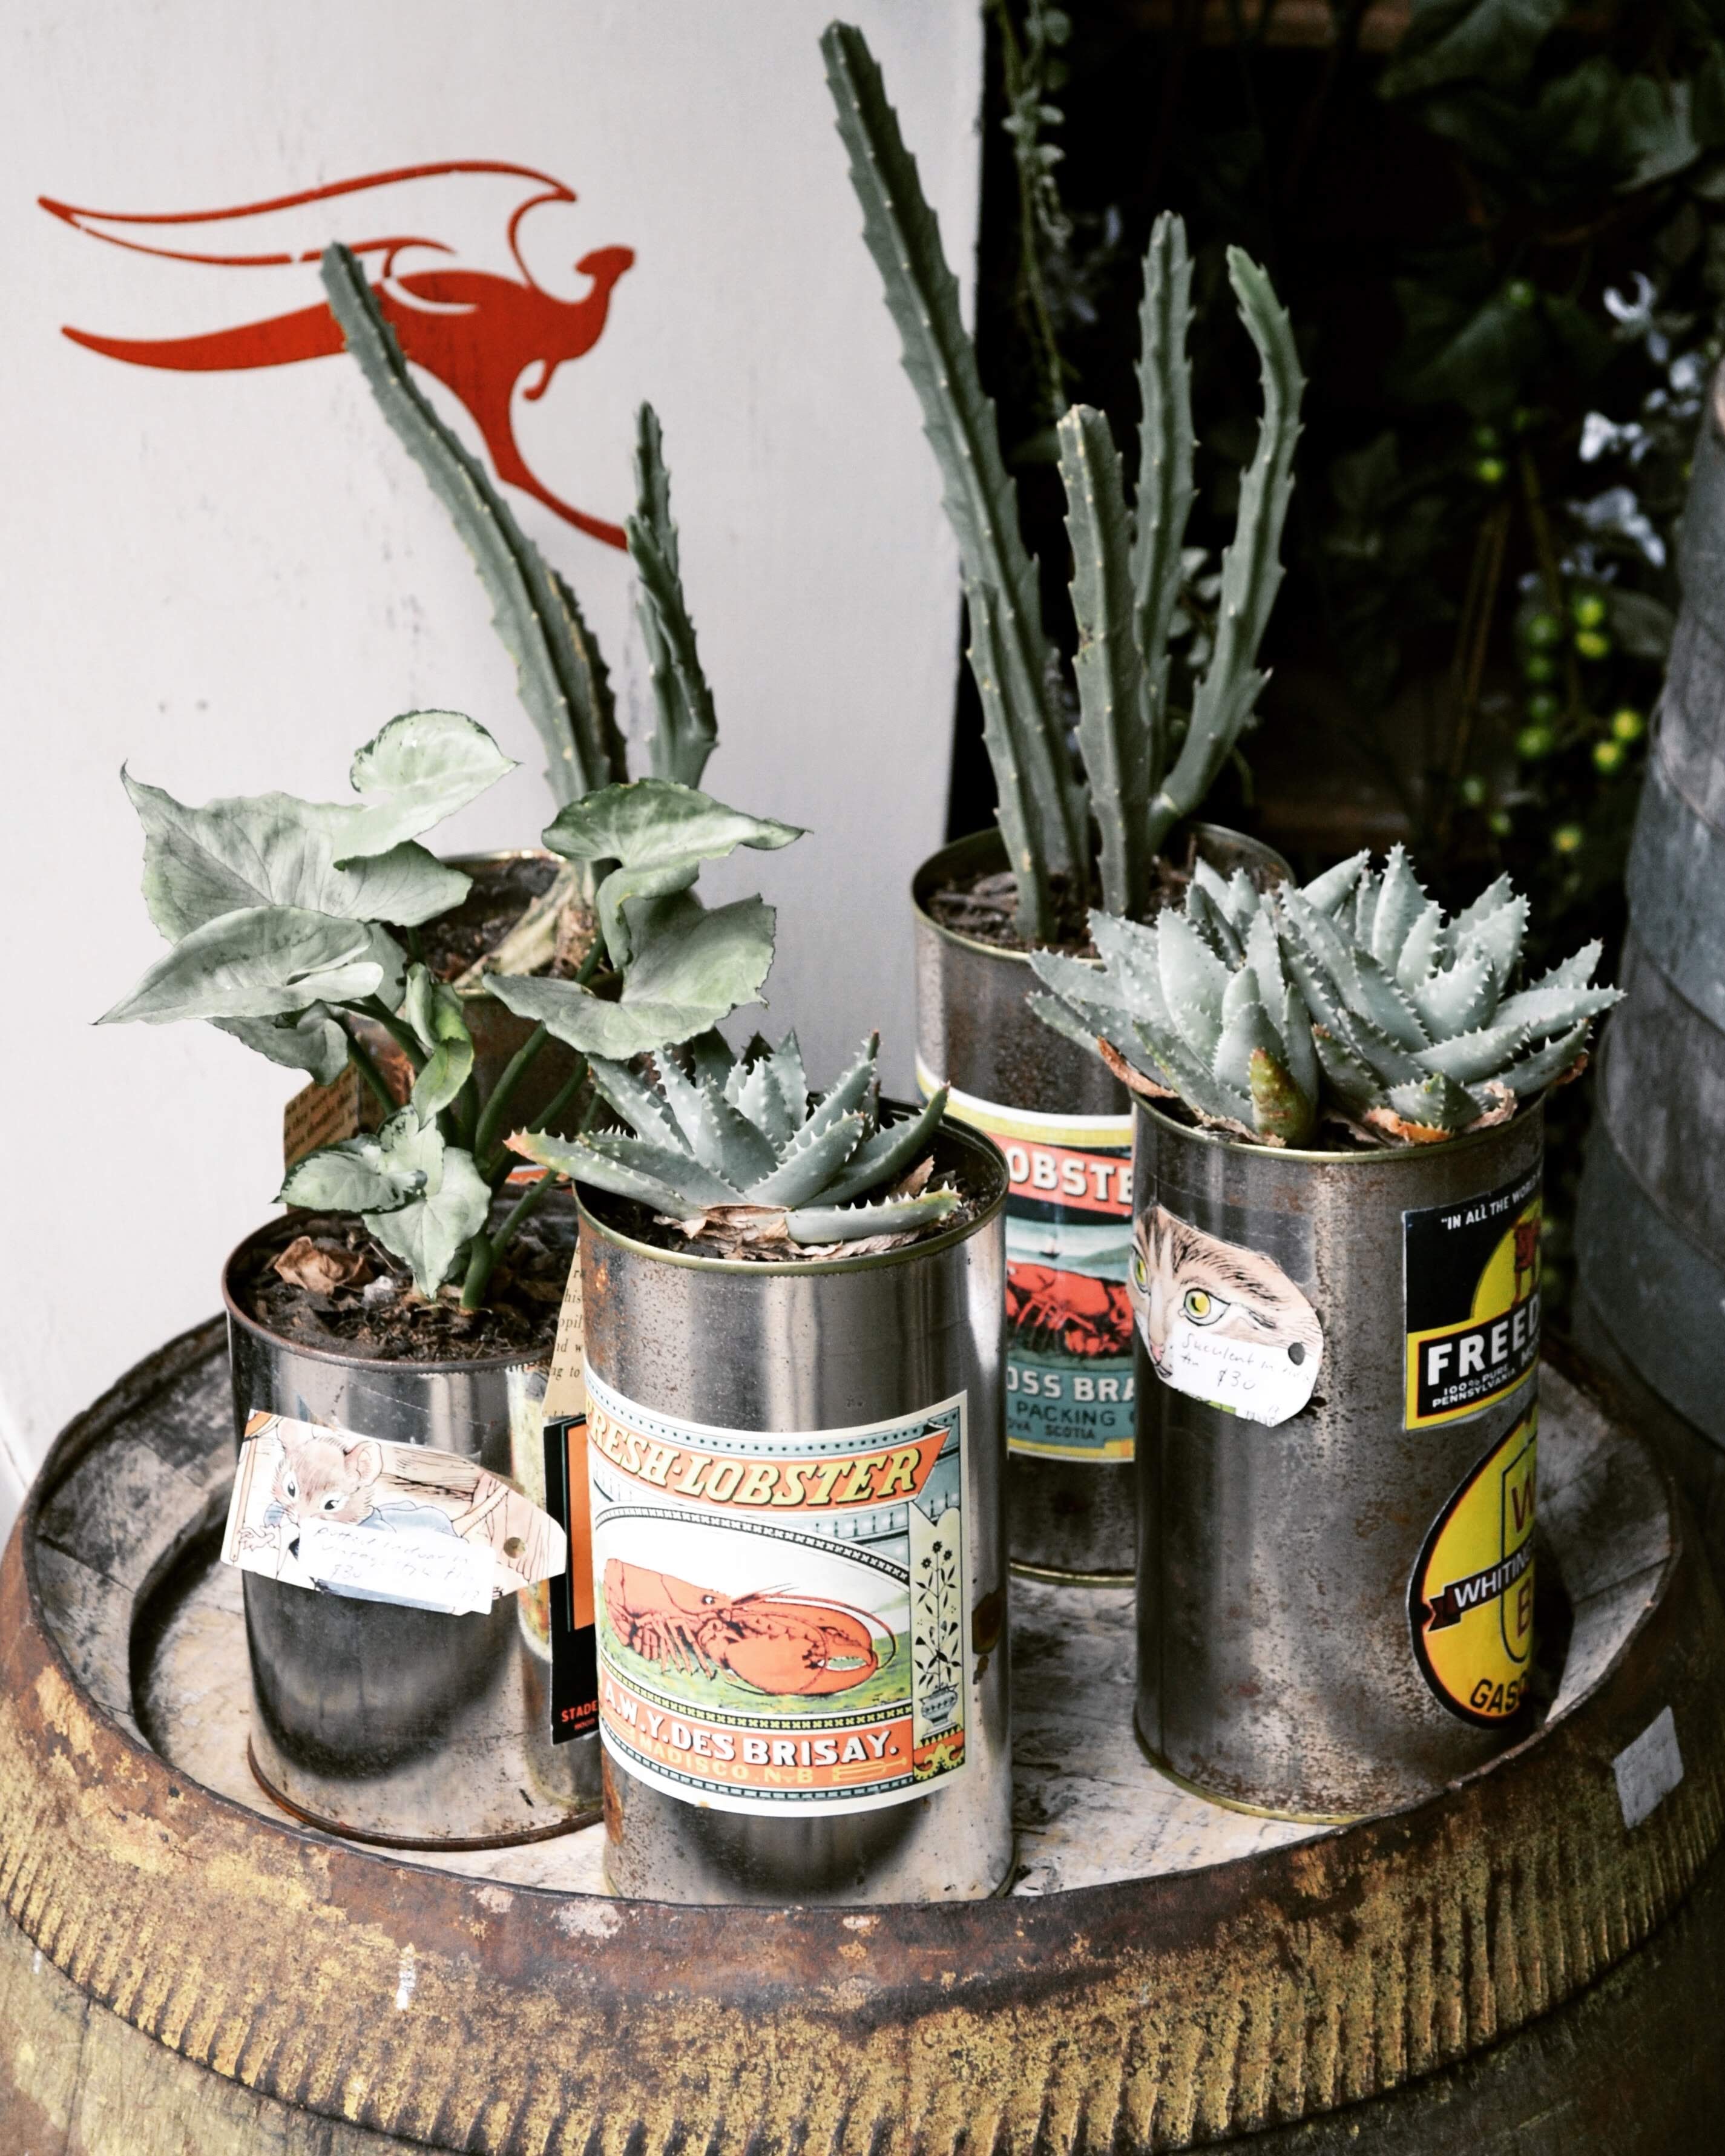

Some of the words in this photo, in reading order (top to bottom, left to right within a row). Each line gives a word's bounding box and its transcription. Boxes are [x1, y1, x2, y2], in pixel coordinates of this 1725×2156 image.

[1465, 1203, 1488, 1225] ALL
[1490, 1195, 1510, 1215] THE
[570, 1366, 581, 1378] to
[1444, 1379, 1480, 1396] 100%
[1017, 1401, 1116, 1427] PACKING
